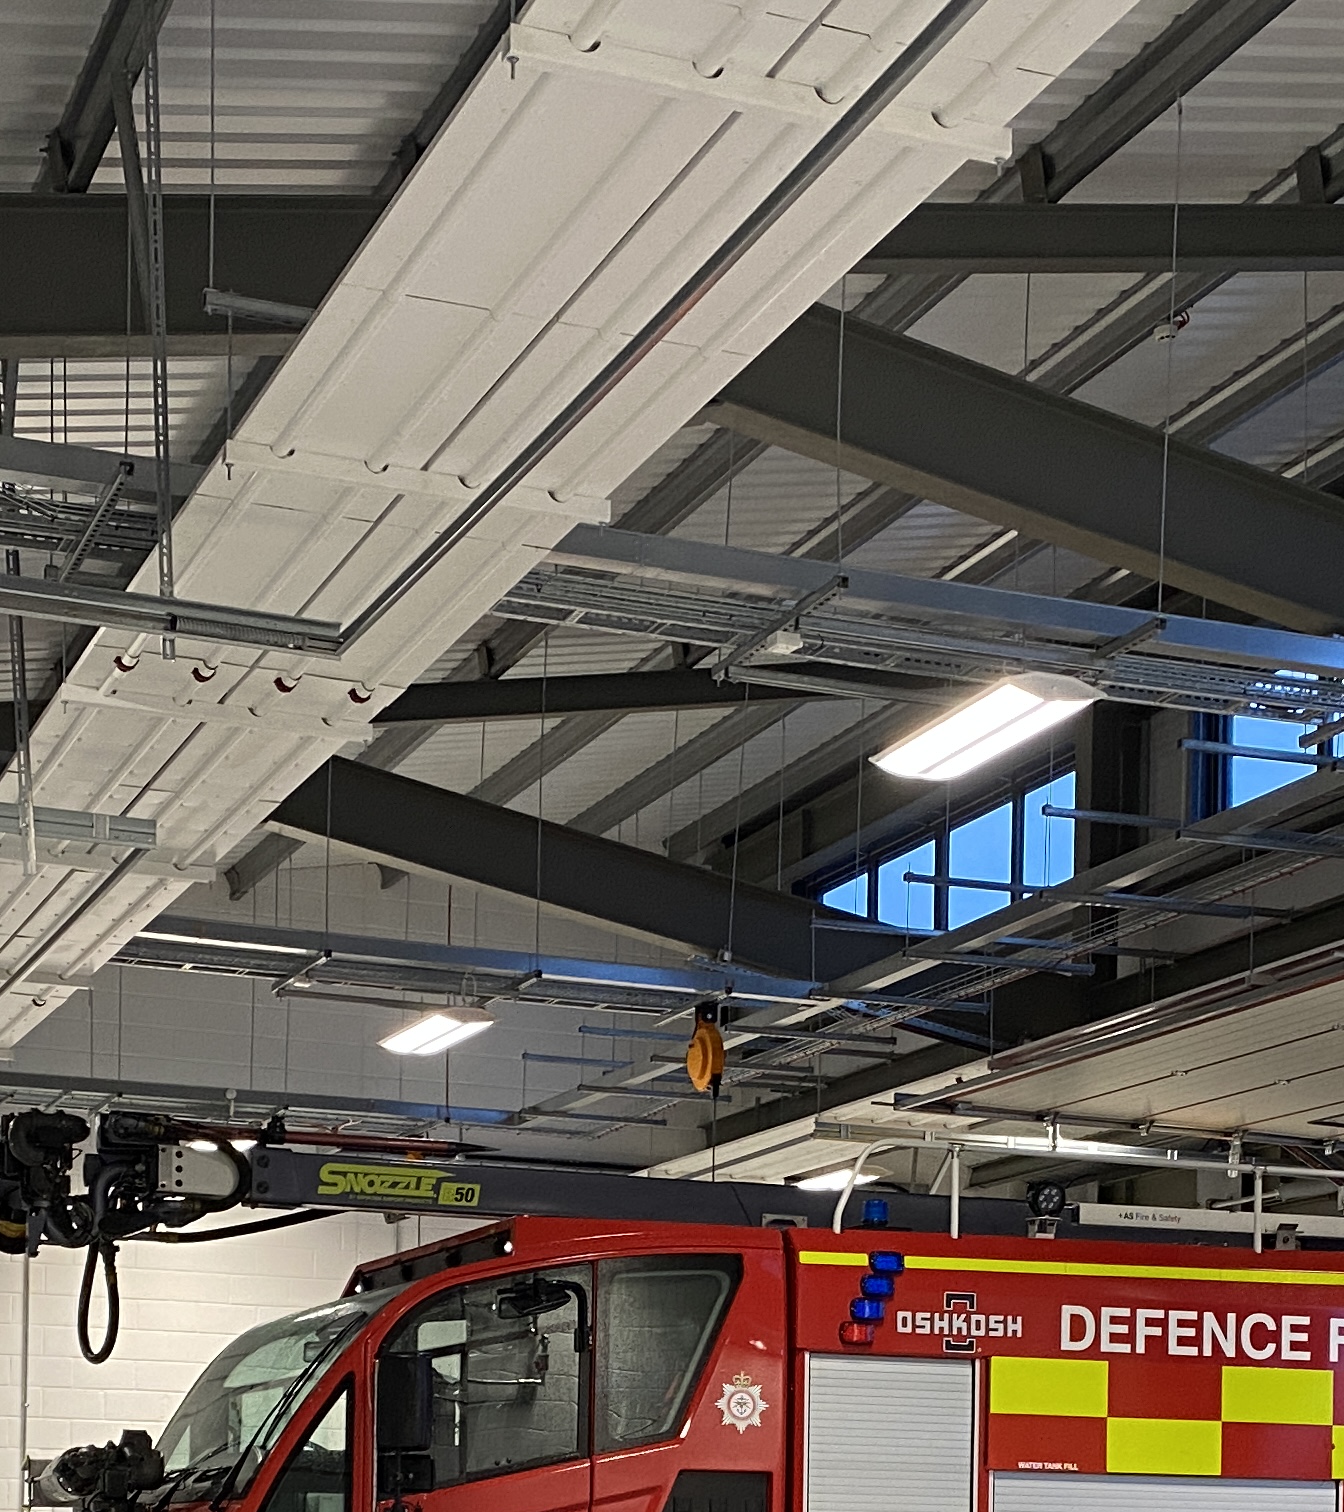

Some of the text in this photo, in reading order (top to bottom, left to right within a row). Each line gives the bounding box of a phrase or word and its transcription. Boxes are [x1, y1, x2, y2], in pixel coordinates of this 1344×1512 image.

[896, 1310, 1023, 1338] OSHKOSH
[1060, 1305, 1312, 1361] DEFENCE
[1018, 1461, 1079, 1471] WATER TANK FILL
